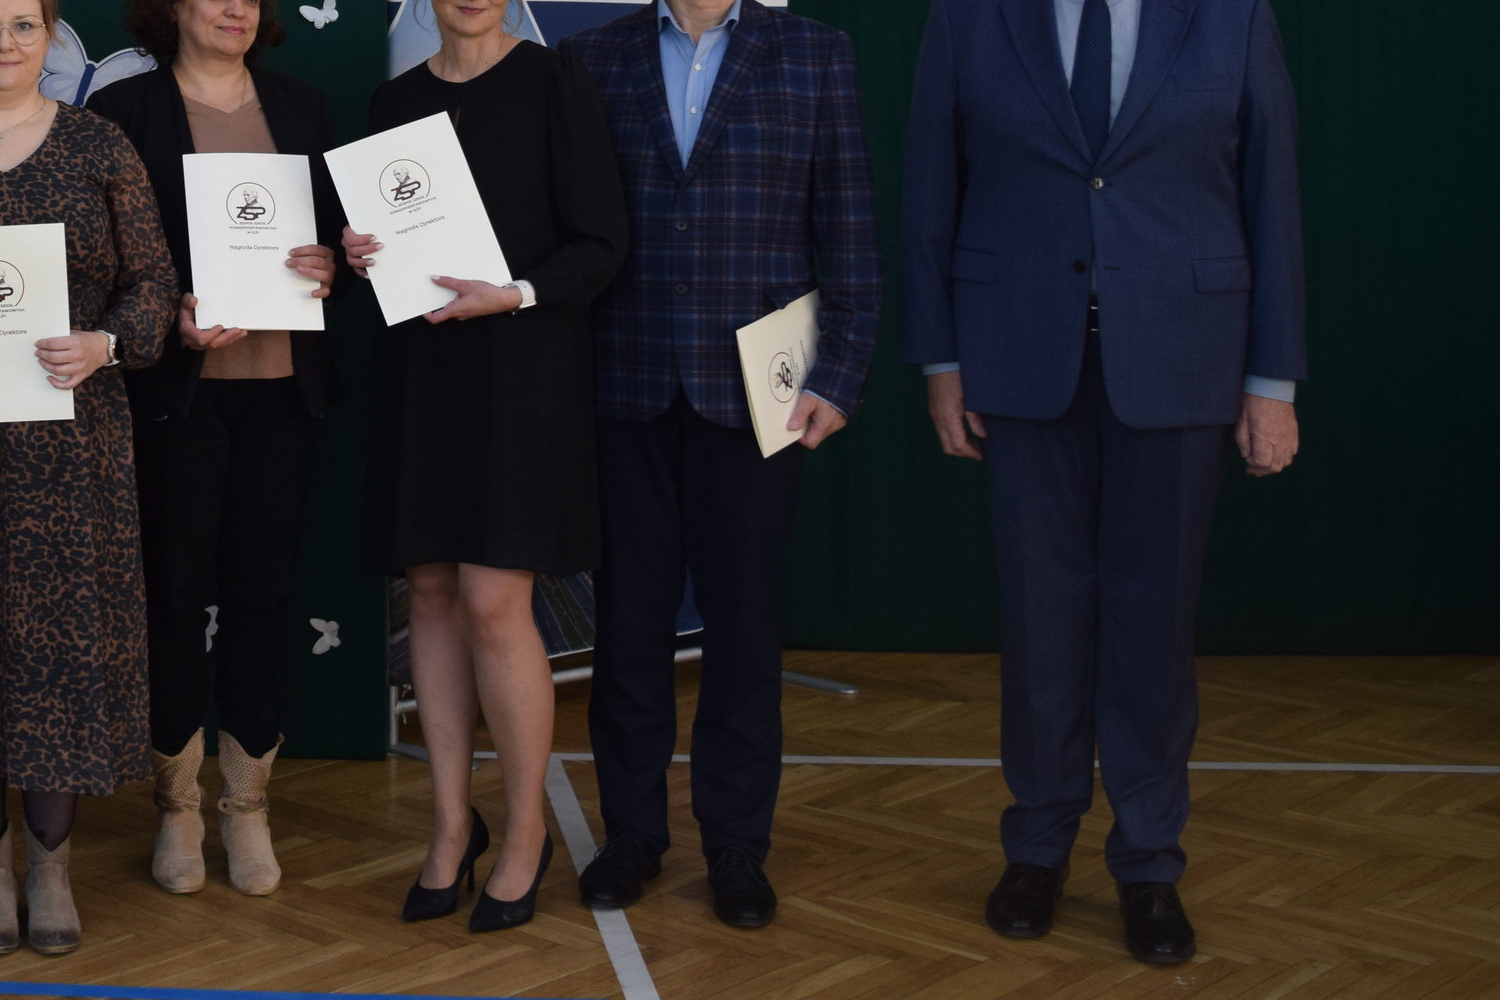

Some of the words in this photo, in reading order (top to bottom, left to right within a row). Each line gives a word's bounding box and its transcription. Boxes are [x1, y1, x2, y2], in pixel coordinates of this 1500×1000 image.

[391, 181, 421, 201] ZSP
[236, 206, 266, 220] ZSP
[396, 224, 418, 235] Nagroda
[419, 215, 445, 227] Dyrektora
